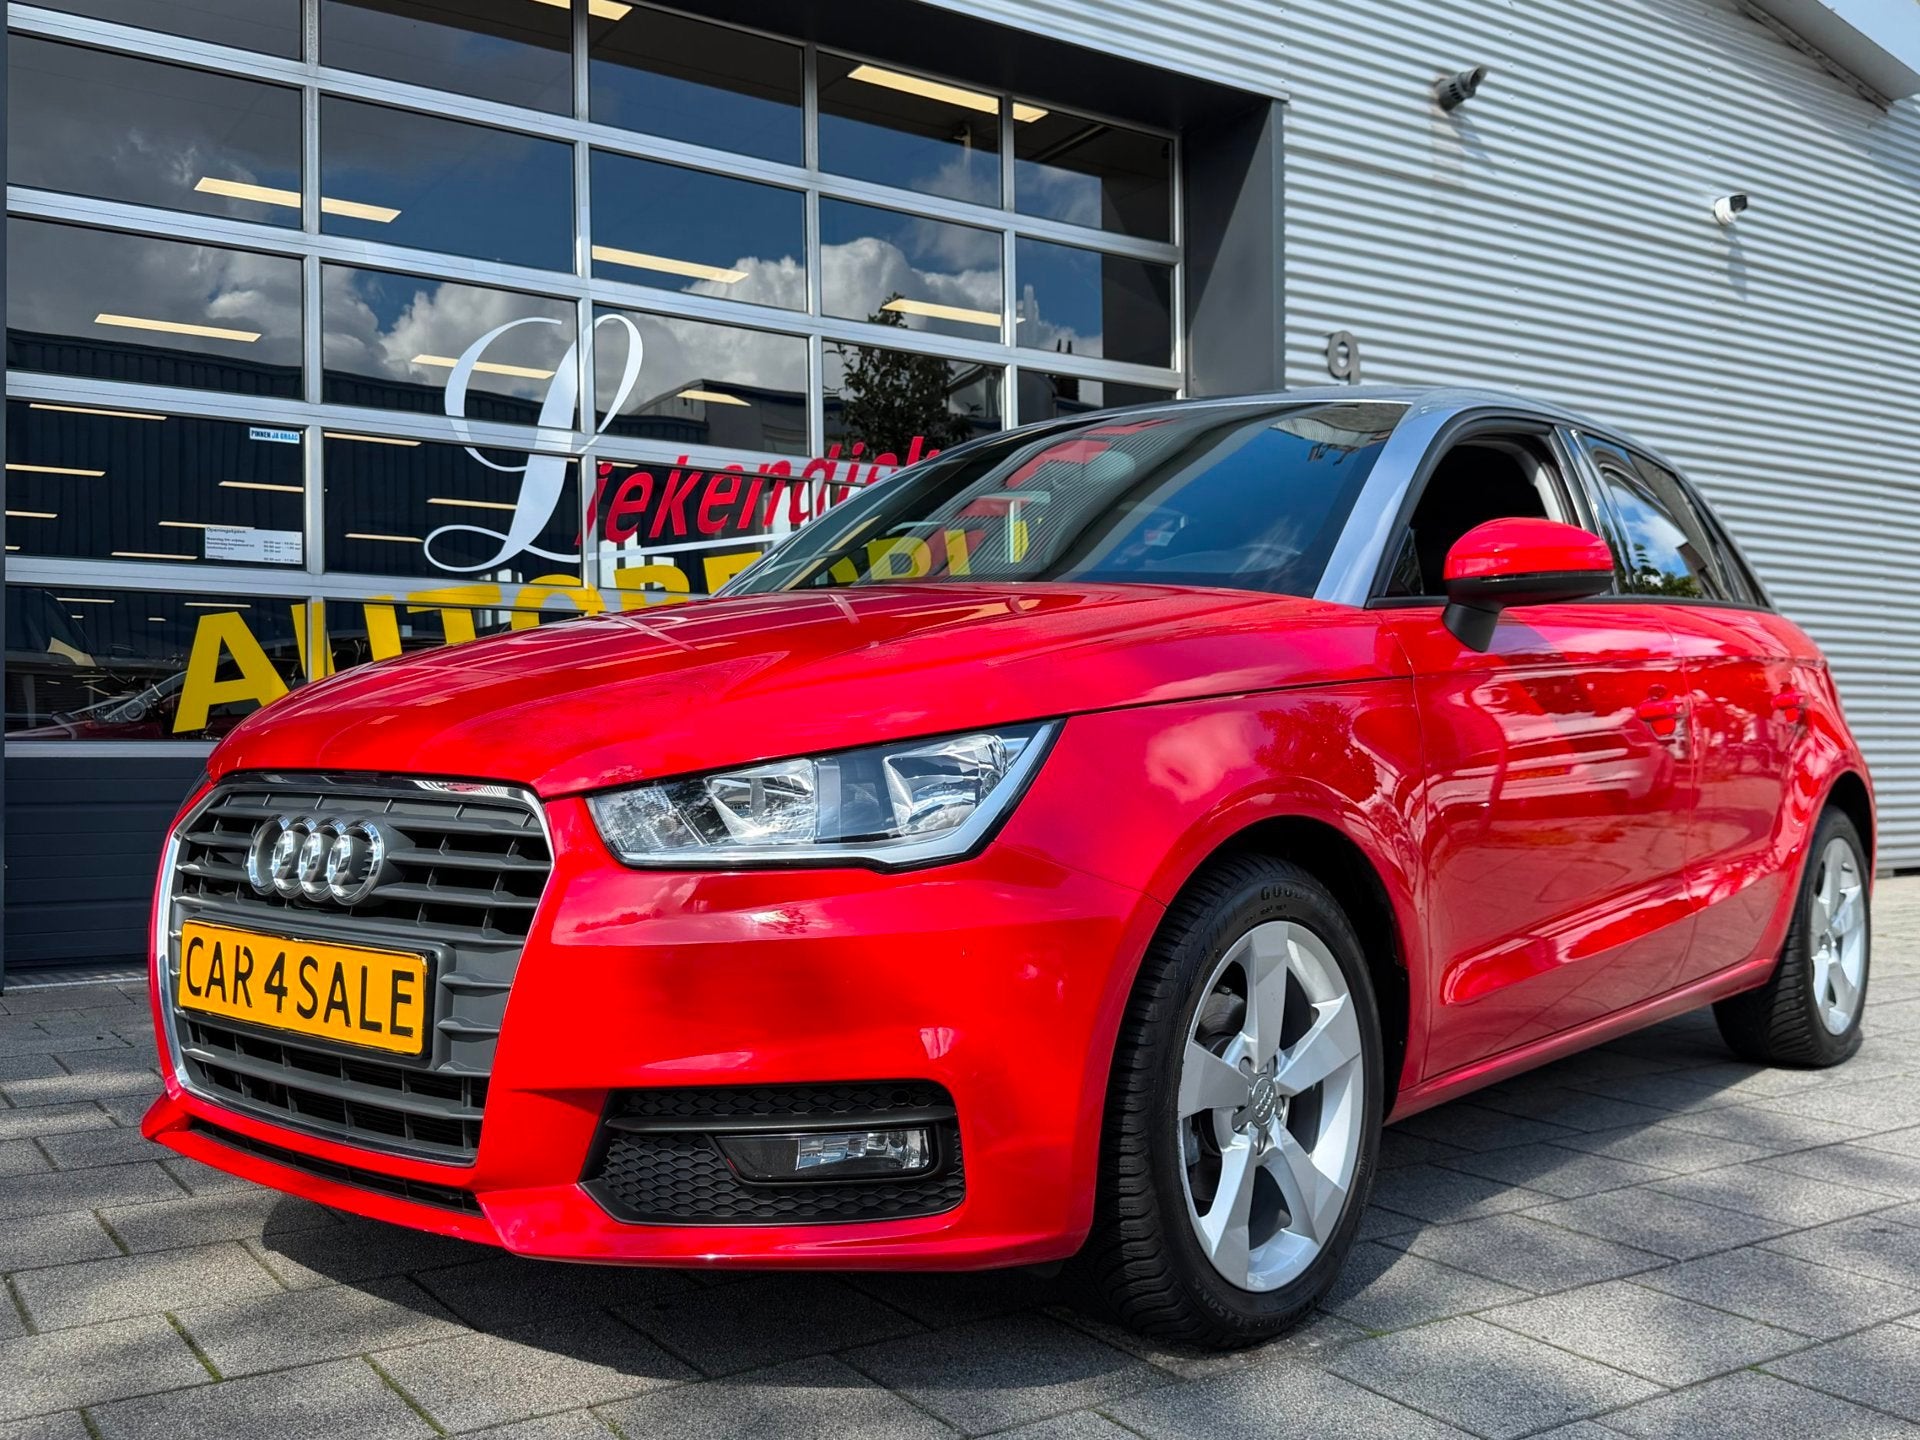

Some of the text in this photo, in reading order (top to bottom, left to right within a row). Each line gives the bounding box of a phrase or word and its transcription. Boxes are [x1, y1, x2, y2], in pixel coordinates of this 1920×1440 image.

[186, 937, 414, 1037] CAR 4 SALE
